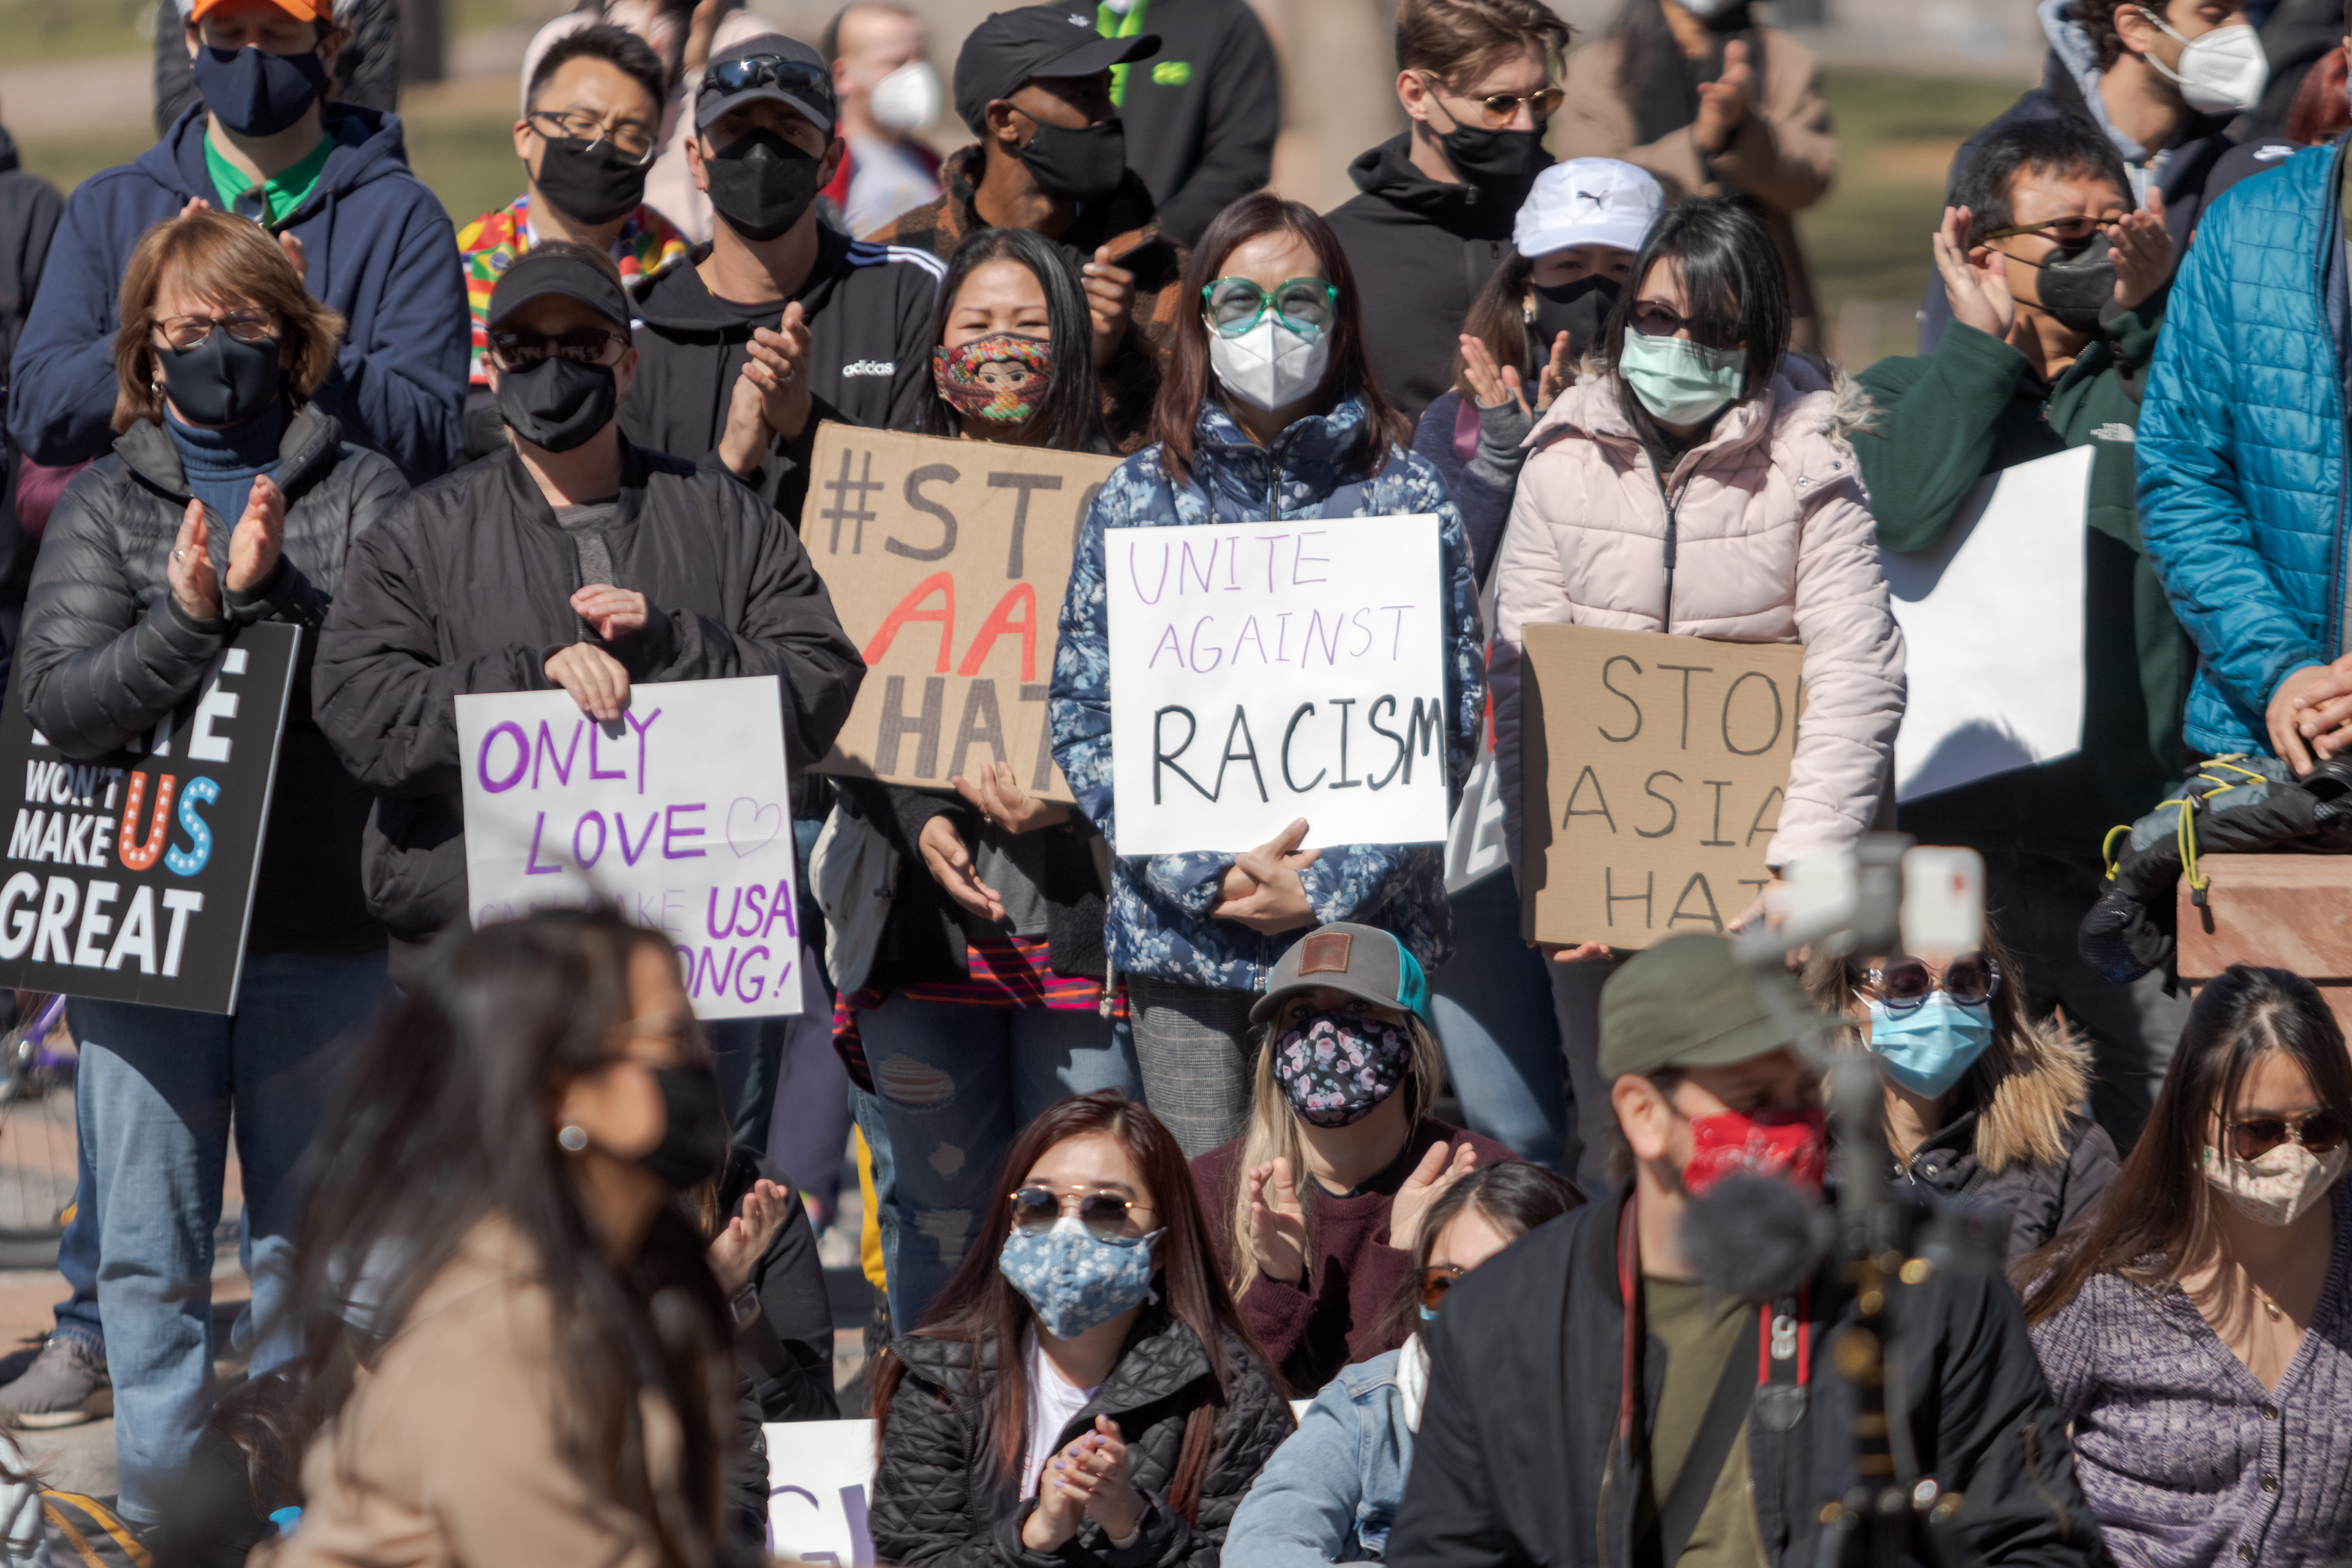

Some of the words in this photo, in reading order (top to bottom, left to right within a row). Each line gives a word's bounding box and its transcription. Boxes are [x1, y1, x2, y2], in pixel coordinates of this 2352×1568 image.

[842, 360, 895, 377] adidas
[819, 448, 1104, 579] #ST
[1129, 530, 1330, 605] UNITE
[863, 571, 1036, 683] AA
[1148, 605, 1415, 674] AGAINST
[477, 707, 662, 794] ONLY
[876, 675, 1054, 792] HAT
[1152, 693, 1446, 806] RACISM
[7, 808, 116, 869] MAKE
[118, 771, 221, 877] US
[25, 759, 123, 810] WON'T
[1562, 765, 1786, 847] ASIA
[524, 803, 707, 875] LOVE
[0, 871, 205, 978] GREAT
[706, 878, 799, 940] USA
[1605, 866, 1771, 933] HA
